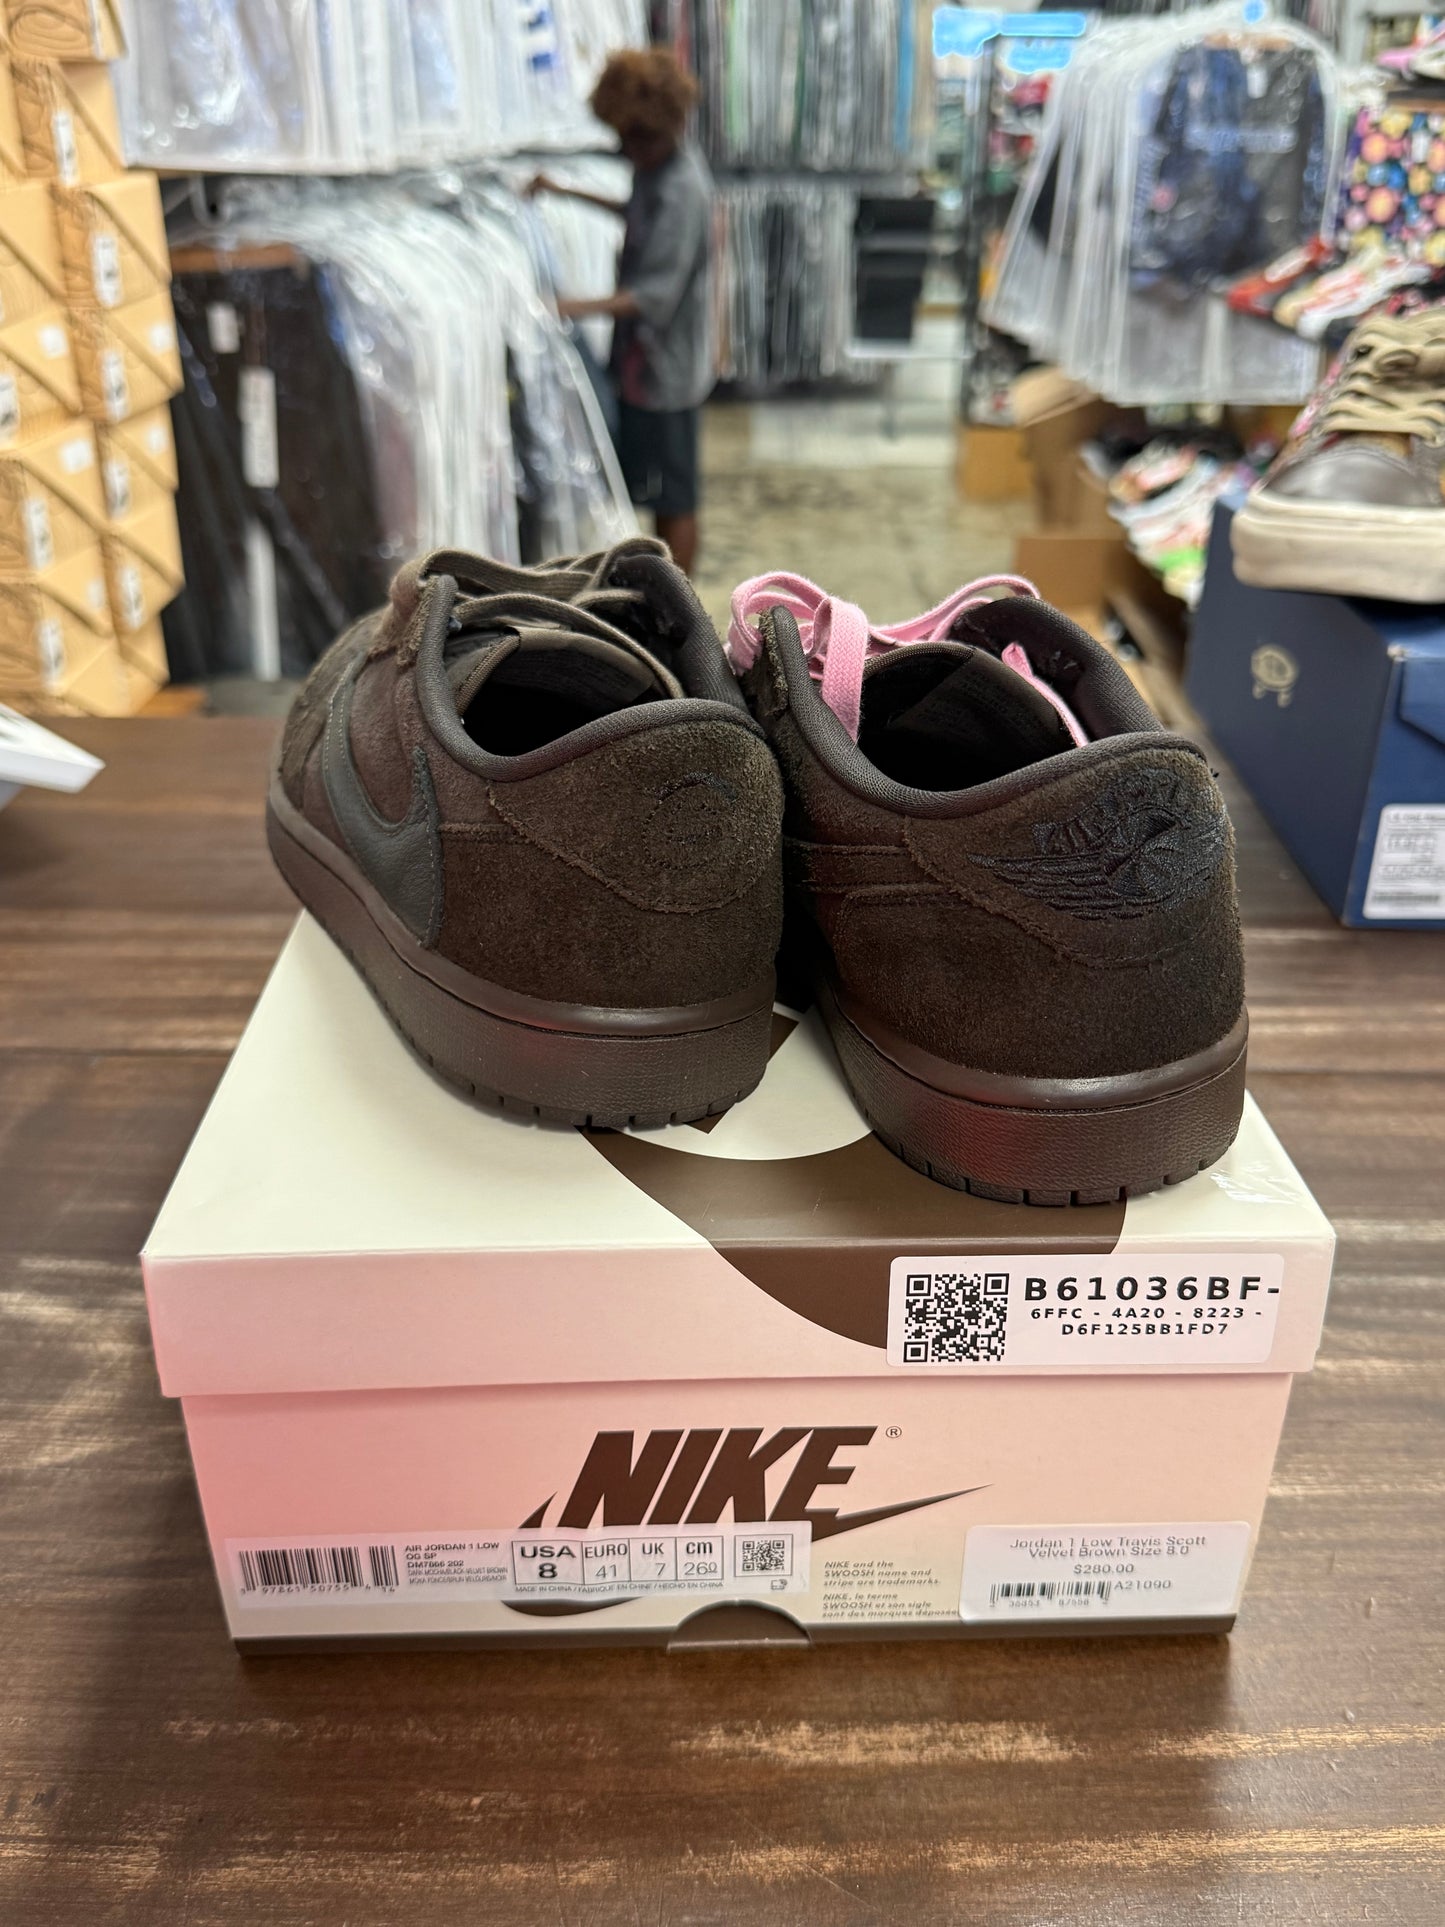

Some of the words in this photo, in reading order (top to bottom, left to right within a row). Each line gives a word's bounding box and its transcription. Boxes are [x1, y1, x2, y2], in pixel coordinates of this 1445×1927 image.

[1024, 1275, 1280, 1301] B61036BF-
[1031, 1307, 1082, 1319] 6FFC
[1111, 1307, 1165, 1319] 4A20
[1192, 1307, 1245, 1319] 8223
[1061, 1322, 1229, 1335] D6F125BB1FD7
[557, 1425, 879, 1528] NIKE
[405, 1544, 422, 1552] AIR
[424, 1543, 466, 1551] JORDAN
[1010, 1538, 1062, 1549] Jordan
[1081, 1537, 1112, 1547] Low
[1117, 1536, 1161, 1547] Travis
[1165, 1535, 1206, 1546] Scott
[520, 1545, 576, 1558] USA
[585, 1543, 628, 1558] EURO
[641, 1542, 665, 1555] UK
[686, 1540, 713, 1554] cm
[1029, 1547, 1074, 1558] Velvet
[1079, 1547, 1126, 1557] Brown
[1130, 1546, 1162, 1556] Size
[538, 1562, 558, 1578] 8
[595, 1564, 618, 1578] 41
[655, 1562, 666, 1576] 7
[824, 1560, 850, 1568] NIKE
[853, 1560, 874, 1568] and
[876, 1560, 894, 1568] the
[1073, 1562, 1135, 1574] $280.00
[824, 1569, 875, 1577] SWOOSH
[911, 1568, 932, 1576] and
[824, 1578, 854, 1587] stripe
[822, 1602, 873, 1610] SWOOSH
[908, 1600, 932, 1609] sigle
